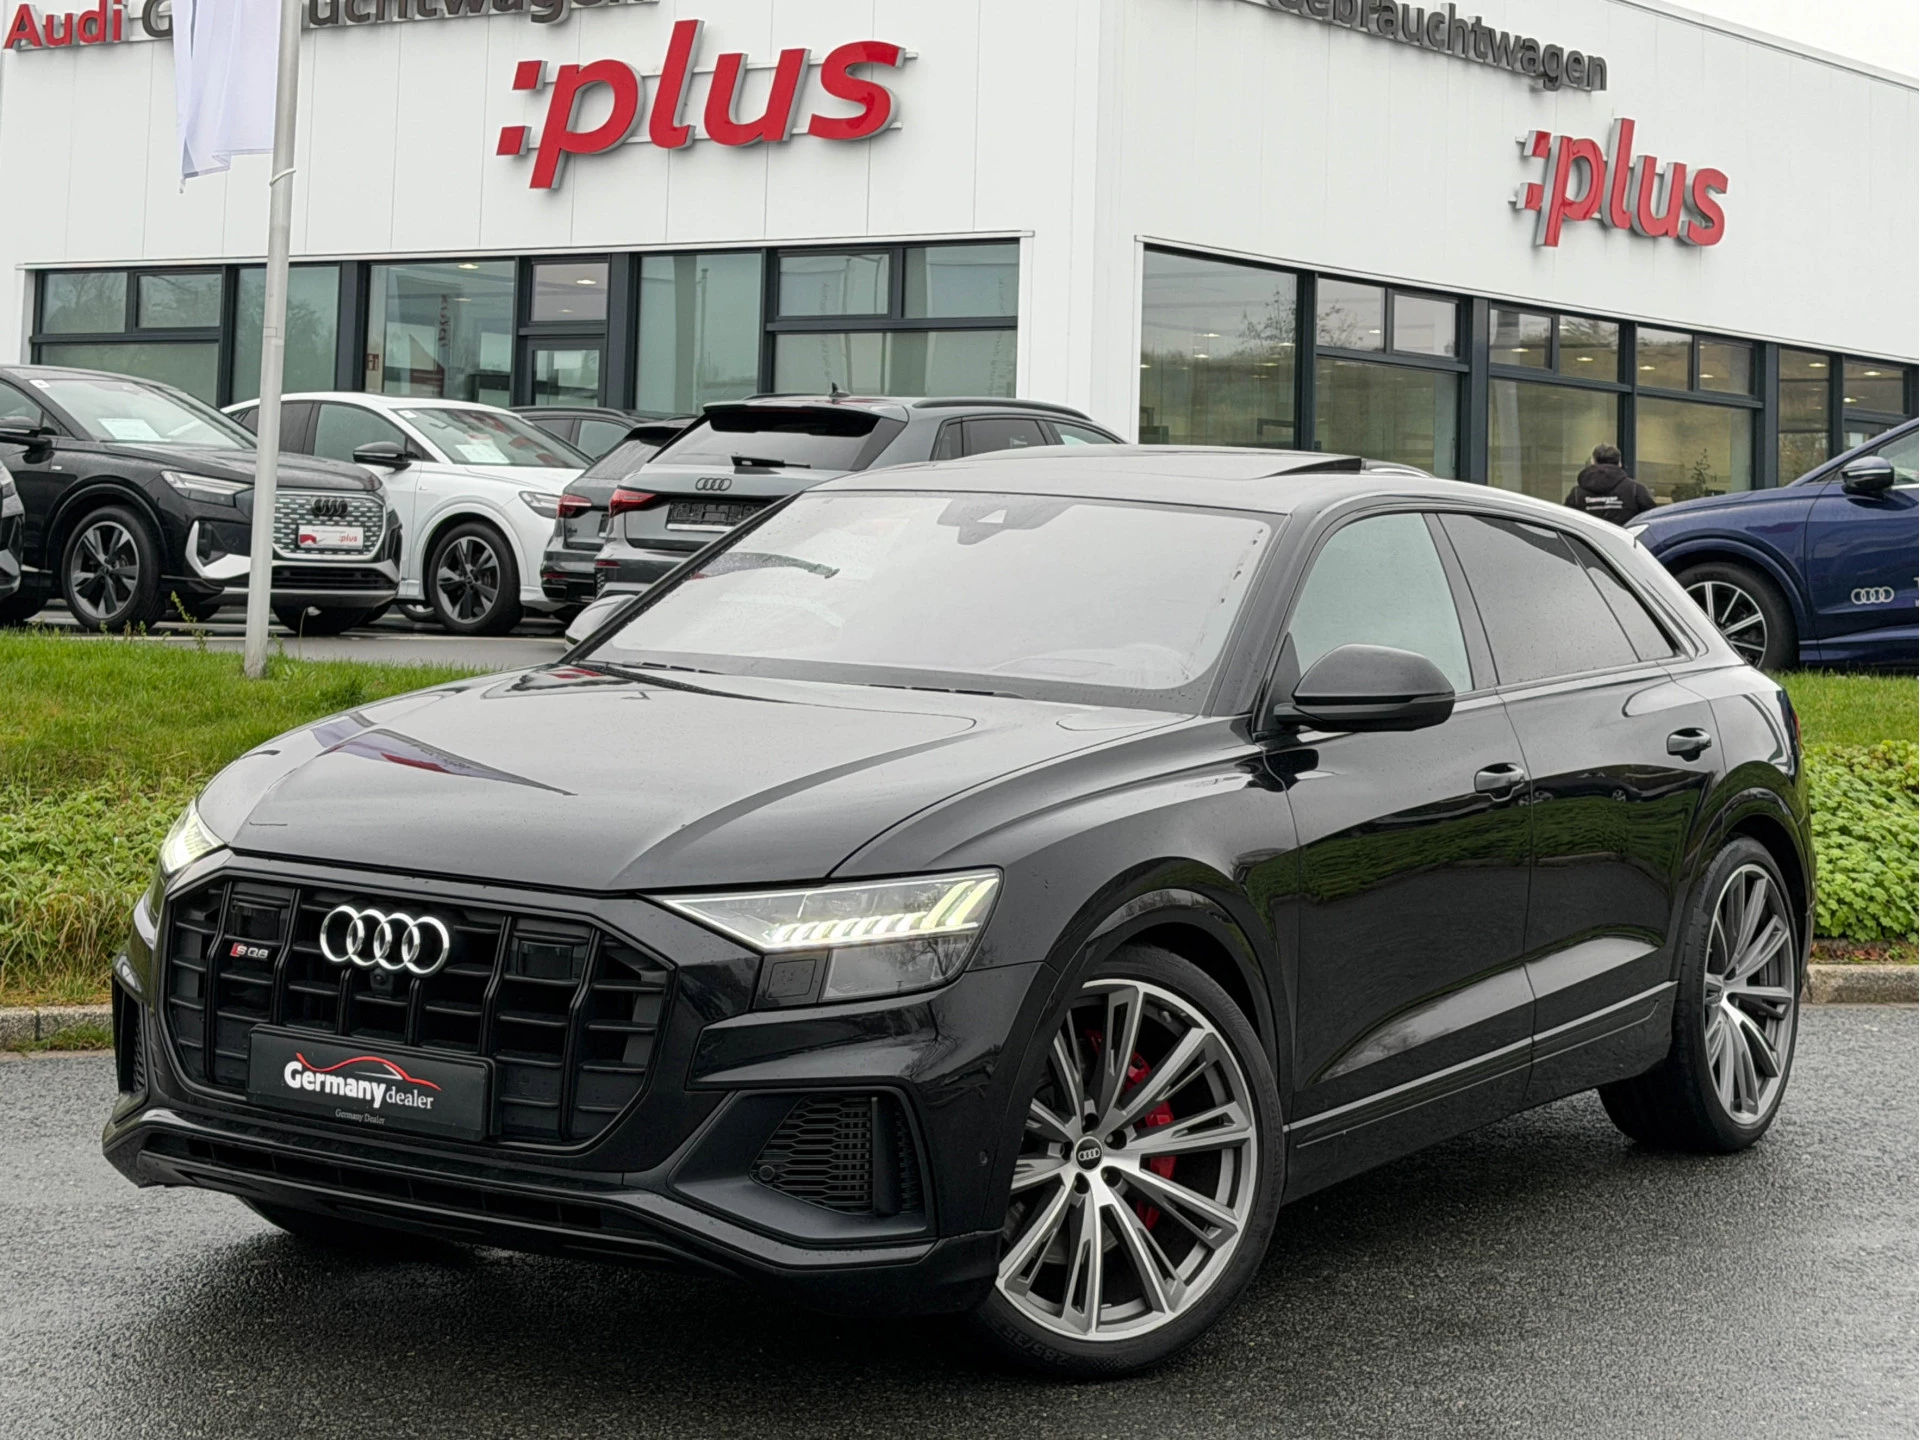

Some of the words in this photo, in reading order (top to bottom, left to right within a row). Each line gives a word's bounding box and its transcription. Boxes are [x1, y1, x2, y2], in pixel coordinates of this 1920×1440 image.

[4, 0, 123, 49] Audi
[235, 944, 269, 959] SQ8
[335, 1108, 363, 1122] Germany
[364, 1113, 386, 1125] Dealer
